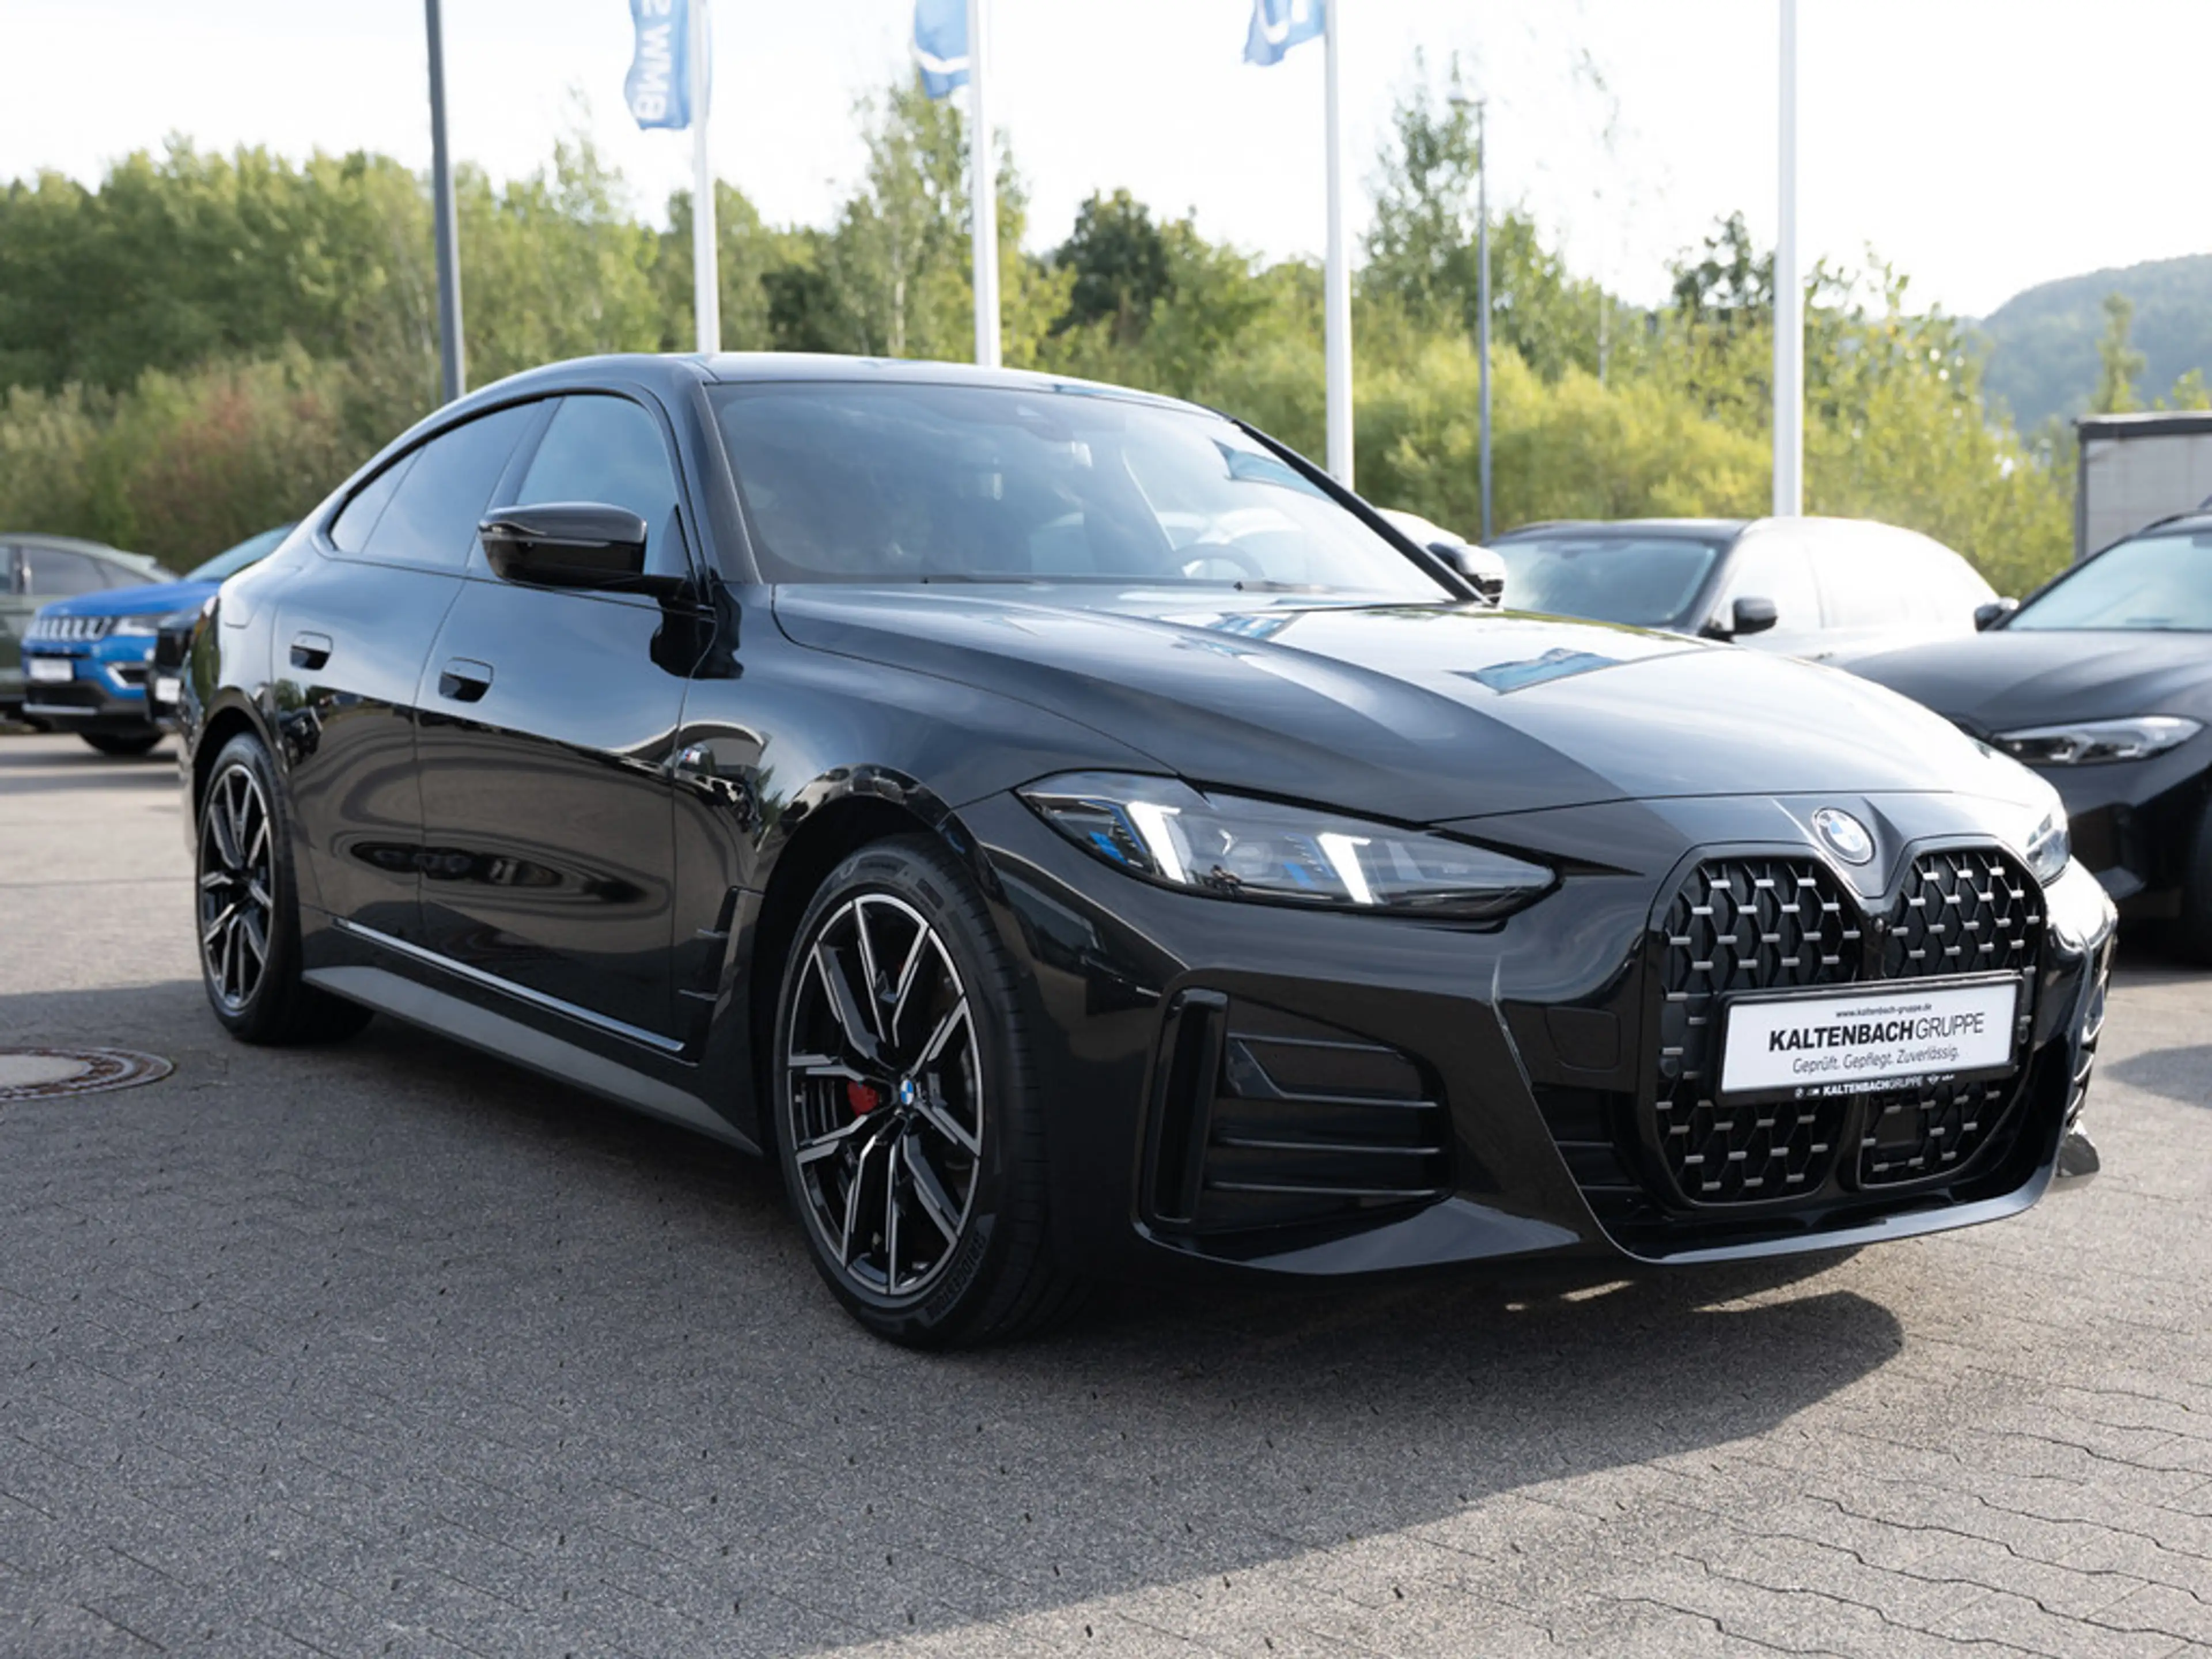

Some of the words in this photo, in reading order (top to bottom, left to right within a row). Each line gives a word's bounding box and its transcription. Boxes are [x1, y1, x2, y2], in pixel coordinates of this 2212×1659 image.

[1793, 1056, 1840, 1074] Geprüft.
[1843, 1051, 1893, 1069] Gepflegt.
[1896, 1046, 1960, 1064] Zuverlässig.
